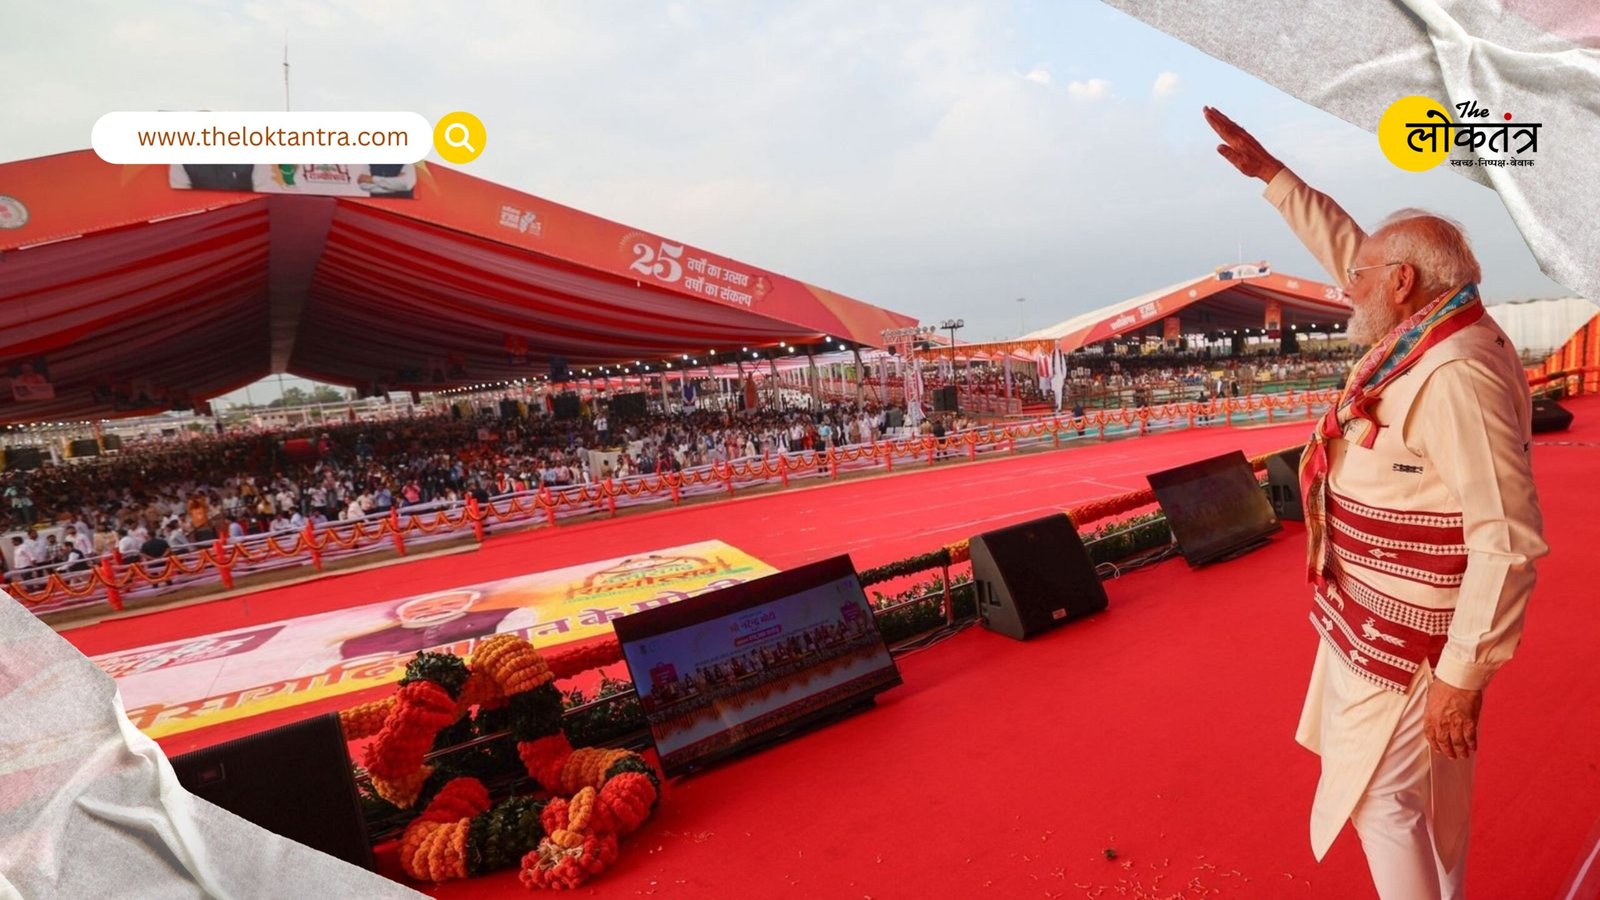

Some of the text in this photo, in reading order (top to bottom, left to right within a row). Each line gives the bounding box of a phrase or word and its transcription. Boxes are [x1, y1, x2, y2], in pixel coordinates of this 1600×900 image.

[630, 242, 684, 282] 25
[707, 264, 722, 279] का
[722, 269, 749, 287] उत्सव
[705, 282, 719, 297] का
[720, 286, 752, 307] संकल्प
